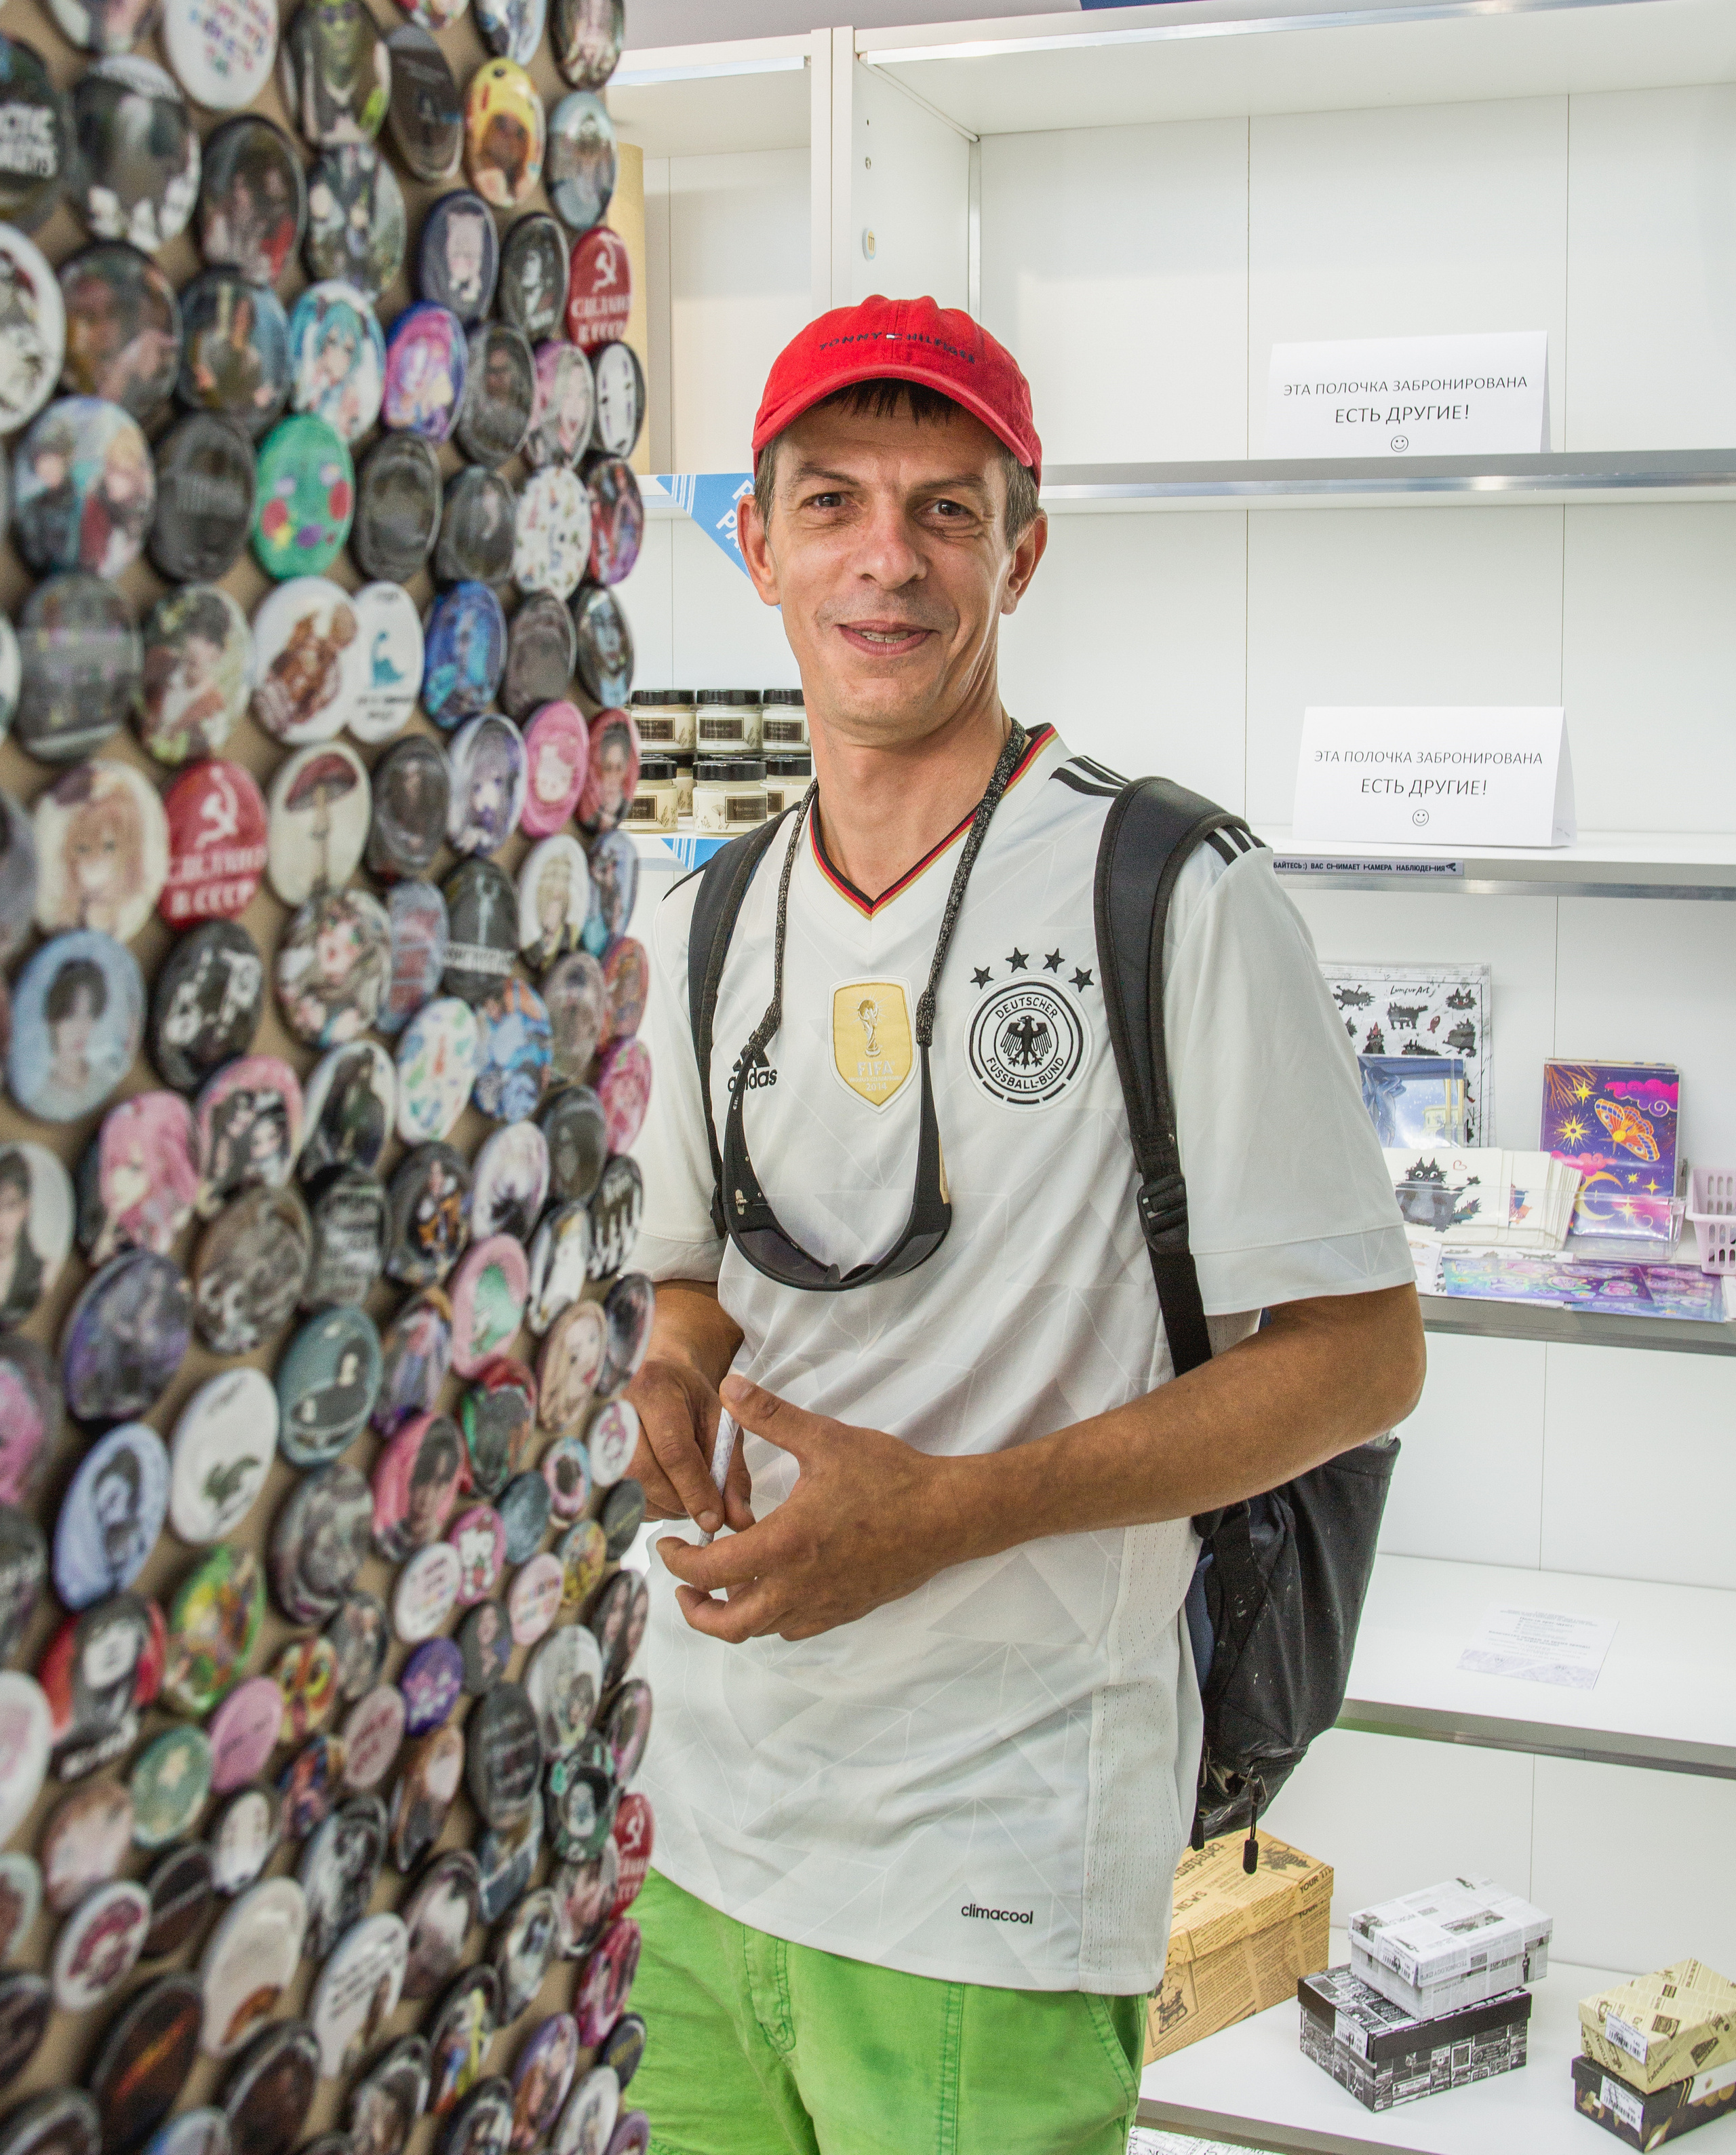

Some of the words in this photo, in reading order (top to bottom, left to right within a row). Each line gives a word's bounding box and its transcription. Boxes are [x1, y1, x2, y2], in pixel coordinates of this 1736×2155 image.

[819, 332, 882, 351] TOMMY
[1284, 384, 1311, 396] ЭТА
[1316, 381, 1388, 395] ПОЛОЧКА
[1392, 376, 1527, 392] ЗАБРОНИРОВАНА
[1335, 407, 1381, 423] ЕСТЬ
[1385, 404, 1469, 424] ДРУГИЕ!
[1314, 750, 1340, 762] ЭТА
[1344, 751, 1412, 764] ПОЛОЧКА
[1416, 751, 1543, 764] ЗАБРОНИРОВАНА
[1360, 779, 1404, 794] ЕСТЬ
[1408, 779, 1486, 797] ДРУГИЕ!
[1396, 863, 1445, 872] НАБЛЮДЕНИЯ
[995, 996, 1058, 1019] DEUTSCHER
[856, 1060, 894, 1076] FIFA
[987, 1057, 1064, 1089] FUSSBALL-BUND
[865, 1082, 887, 1091] 2014
[1299, 1874, 1320, 1895] YOUR
[1174, 1890, 1208, 1911] NEWS
[961, 1903, 1034, 1925] climacool
